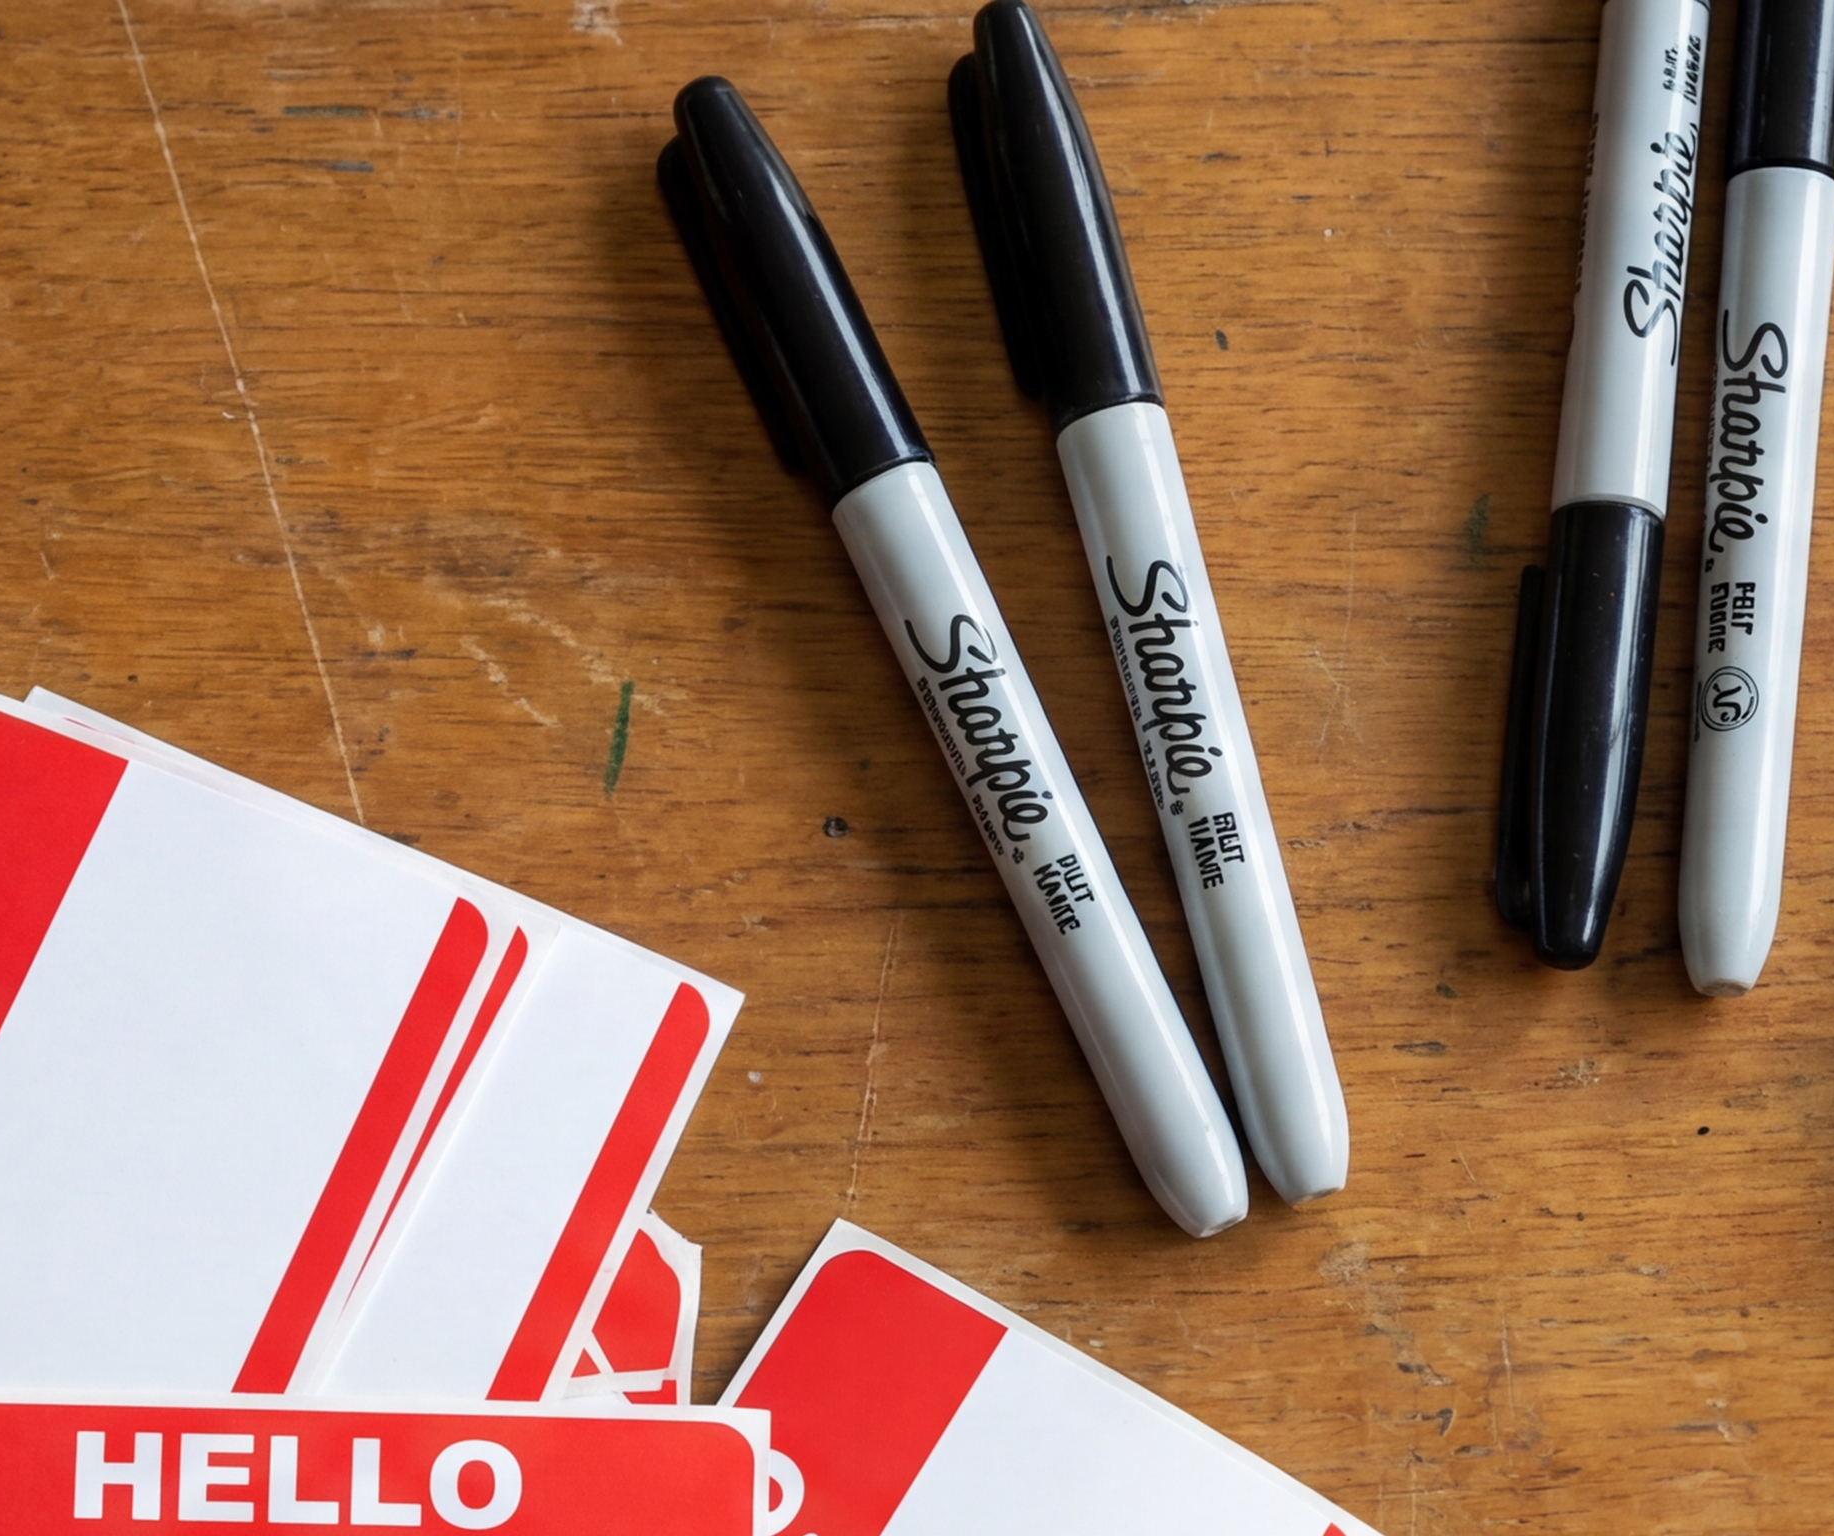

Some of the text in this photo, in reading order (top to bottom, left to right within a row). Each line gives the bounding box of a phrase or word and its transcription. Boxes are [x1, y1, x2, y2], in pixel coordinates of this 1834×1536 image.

[1622, 123, 1699, 367] Sharpie
[1708, 309, 1789, 554] Sharpie
[904, 613, 1054, 843] Sharpie
[1106, 554, 1223, 797] Sharpie
[74, 1431, 522, 1530] HELLO
